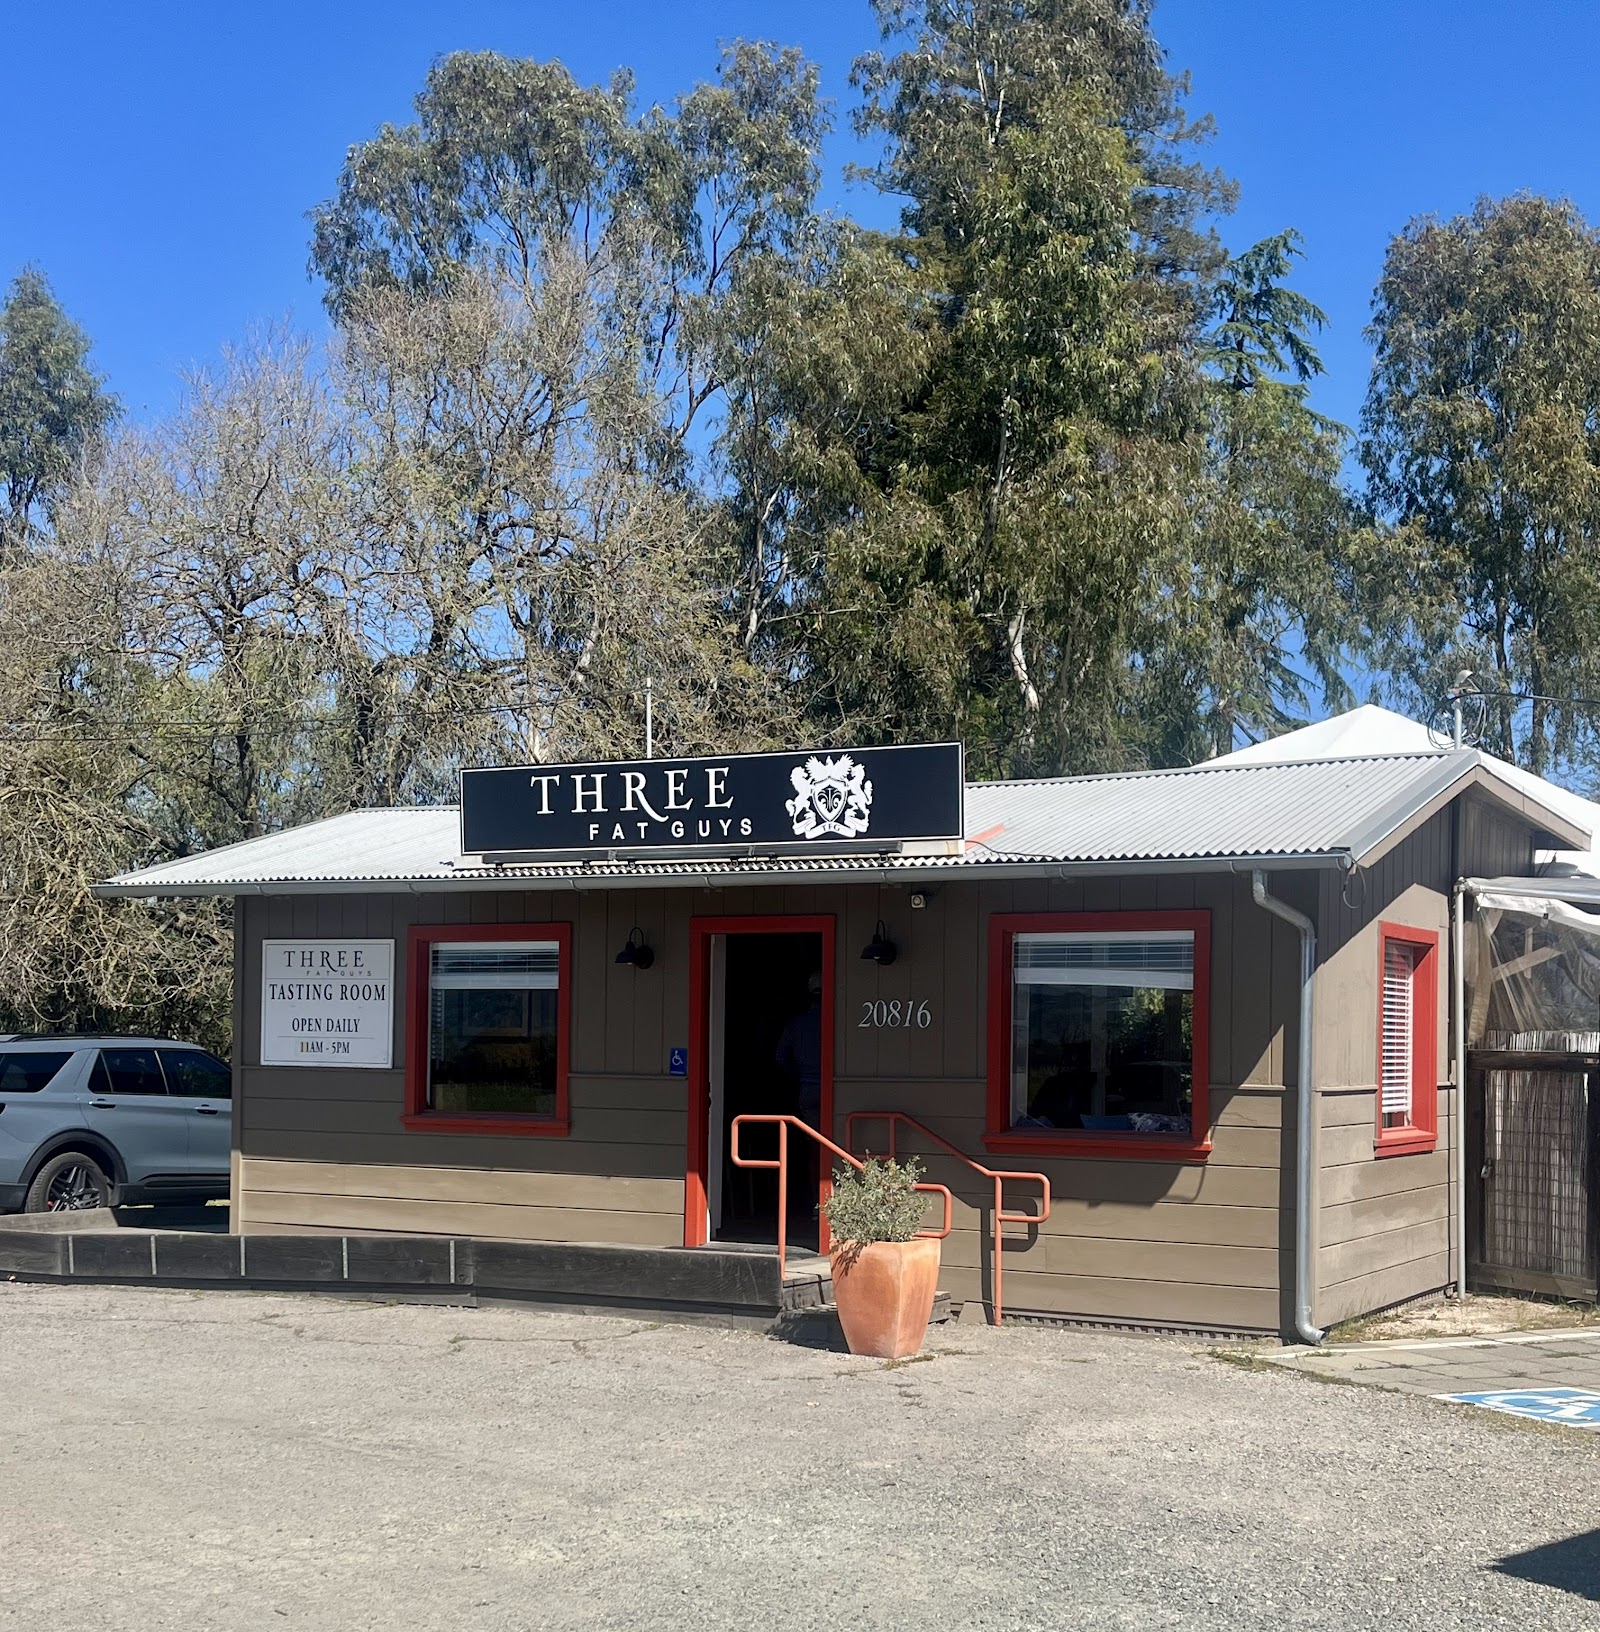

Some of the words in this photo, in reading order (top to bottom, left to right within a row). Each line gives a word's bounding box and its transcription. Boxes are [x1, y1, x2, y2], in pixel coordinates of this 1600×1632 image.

[530, 766, 735, 822] THREE
[589, 822, 652, 841] FAT
[671, 817, 753, 839] GUYS
[821, 823, 841, 832] TFG
[283, 950, 365, 972] THREE
[269, 983, 333, 1001] TASTING
[340, 984, 386, 1001] ROOM
[857, 999, 932, 1029] 20816
[292, 1017, 322, 1032] OPEN
[326, 1018, 361, 1033] DAILY
[300, 1041, 323, 1053] 11AM
[332, 1042, 350, 1054] 5PM
